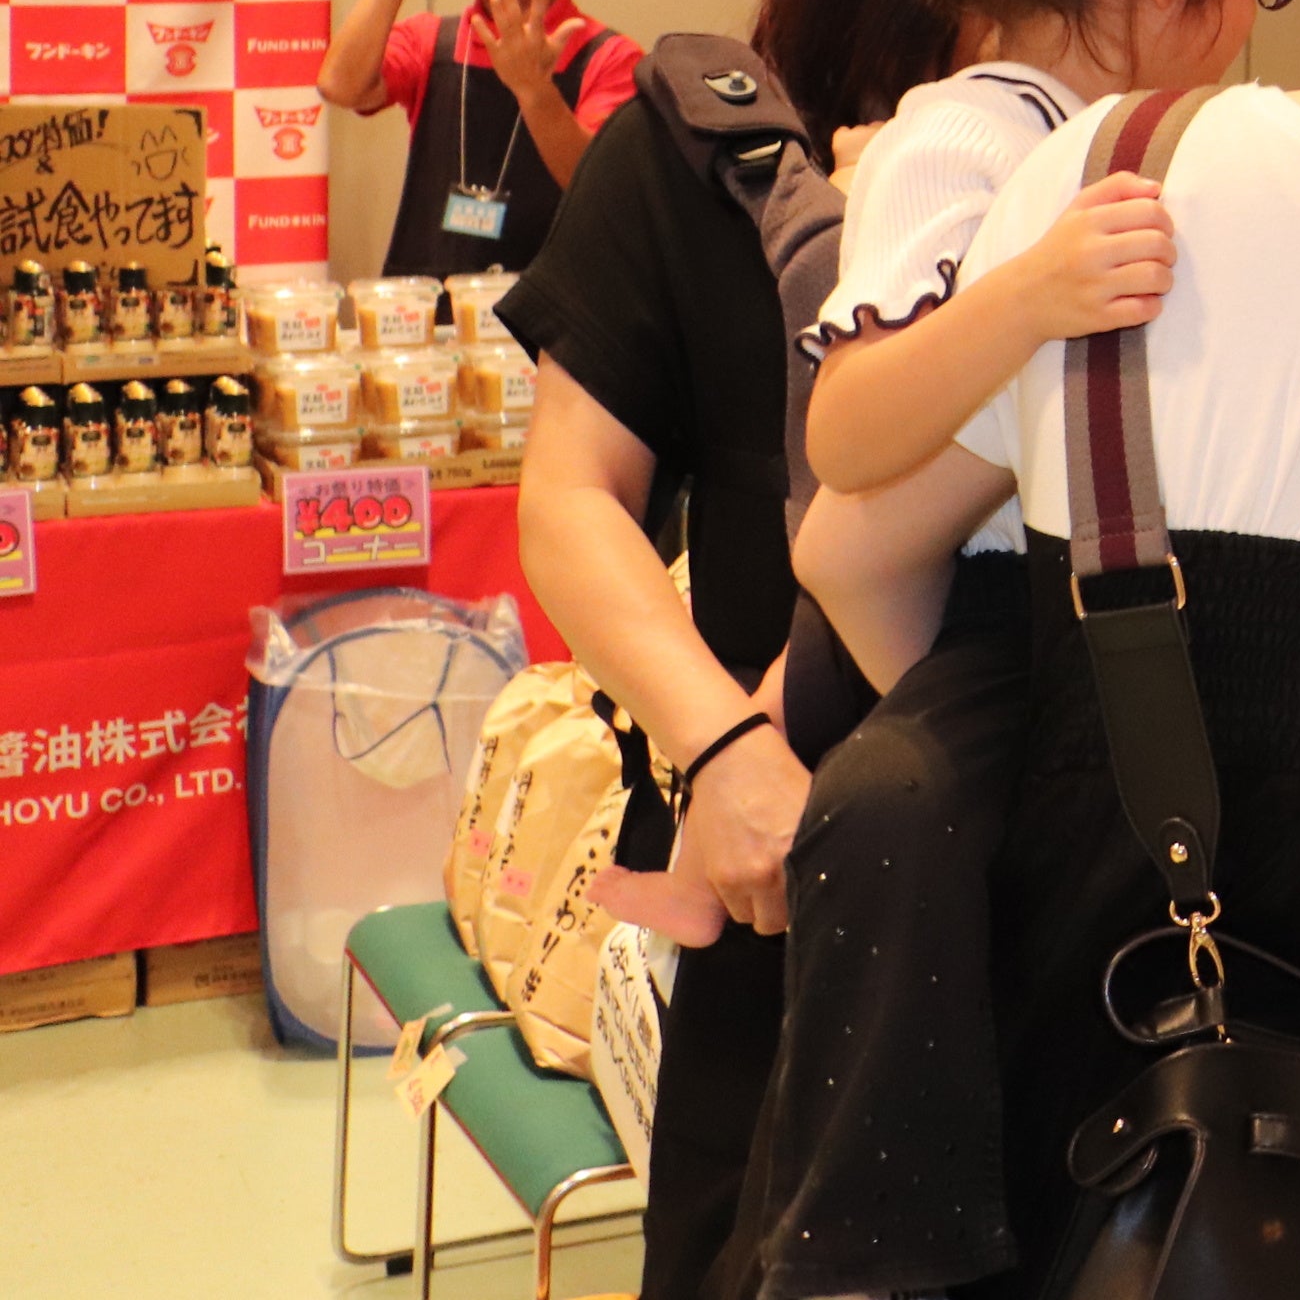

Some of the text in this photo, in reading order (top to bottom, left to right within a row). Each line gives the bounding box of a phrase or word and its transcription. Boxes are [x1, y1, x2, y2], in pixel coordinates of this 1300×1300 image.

[25, 42, 111, 61] フンドーキン
[296, 493, 412, 538] ¥400
[303, 535, 419, 565] コーナー
[100, 783, 164, 814] CO.,
[174, 767, 242, 799] LTD.
